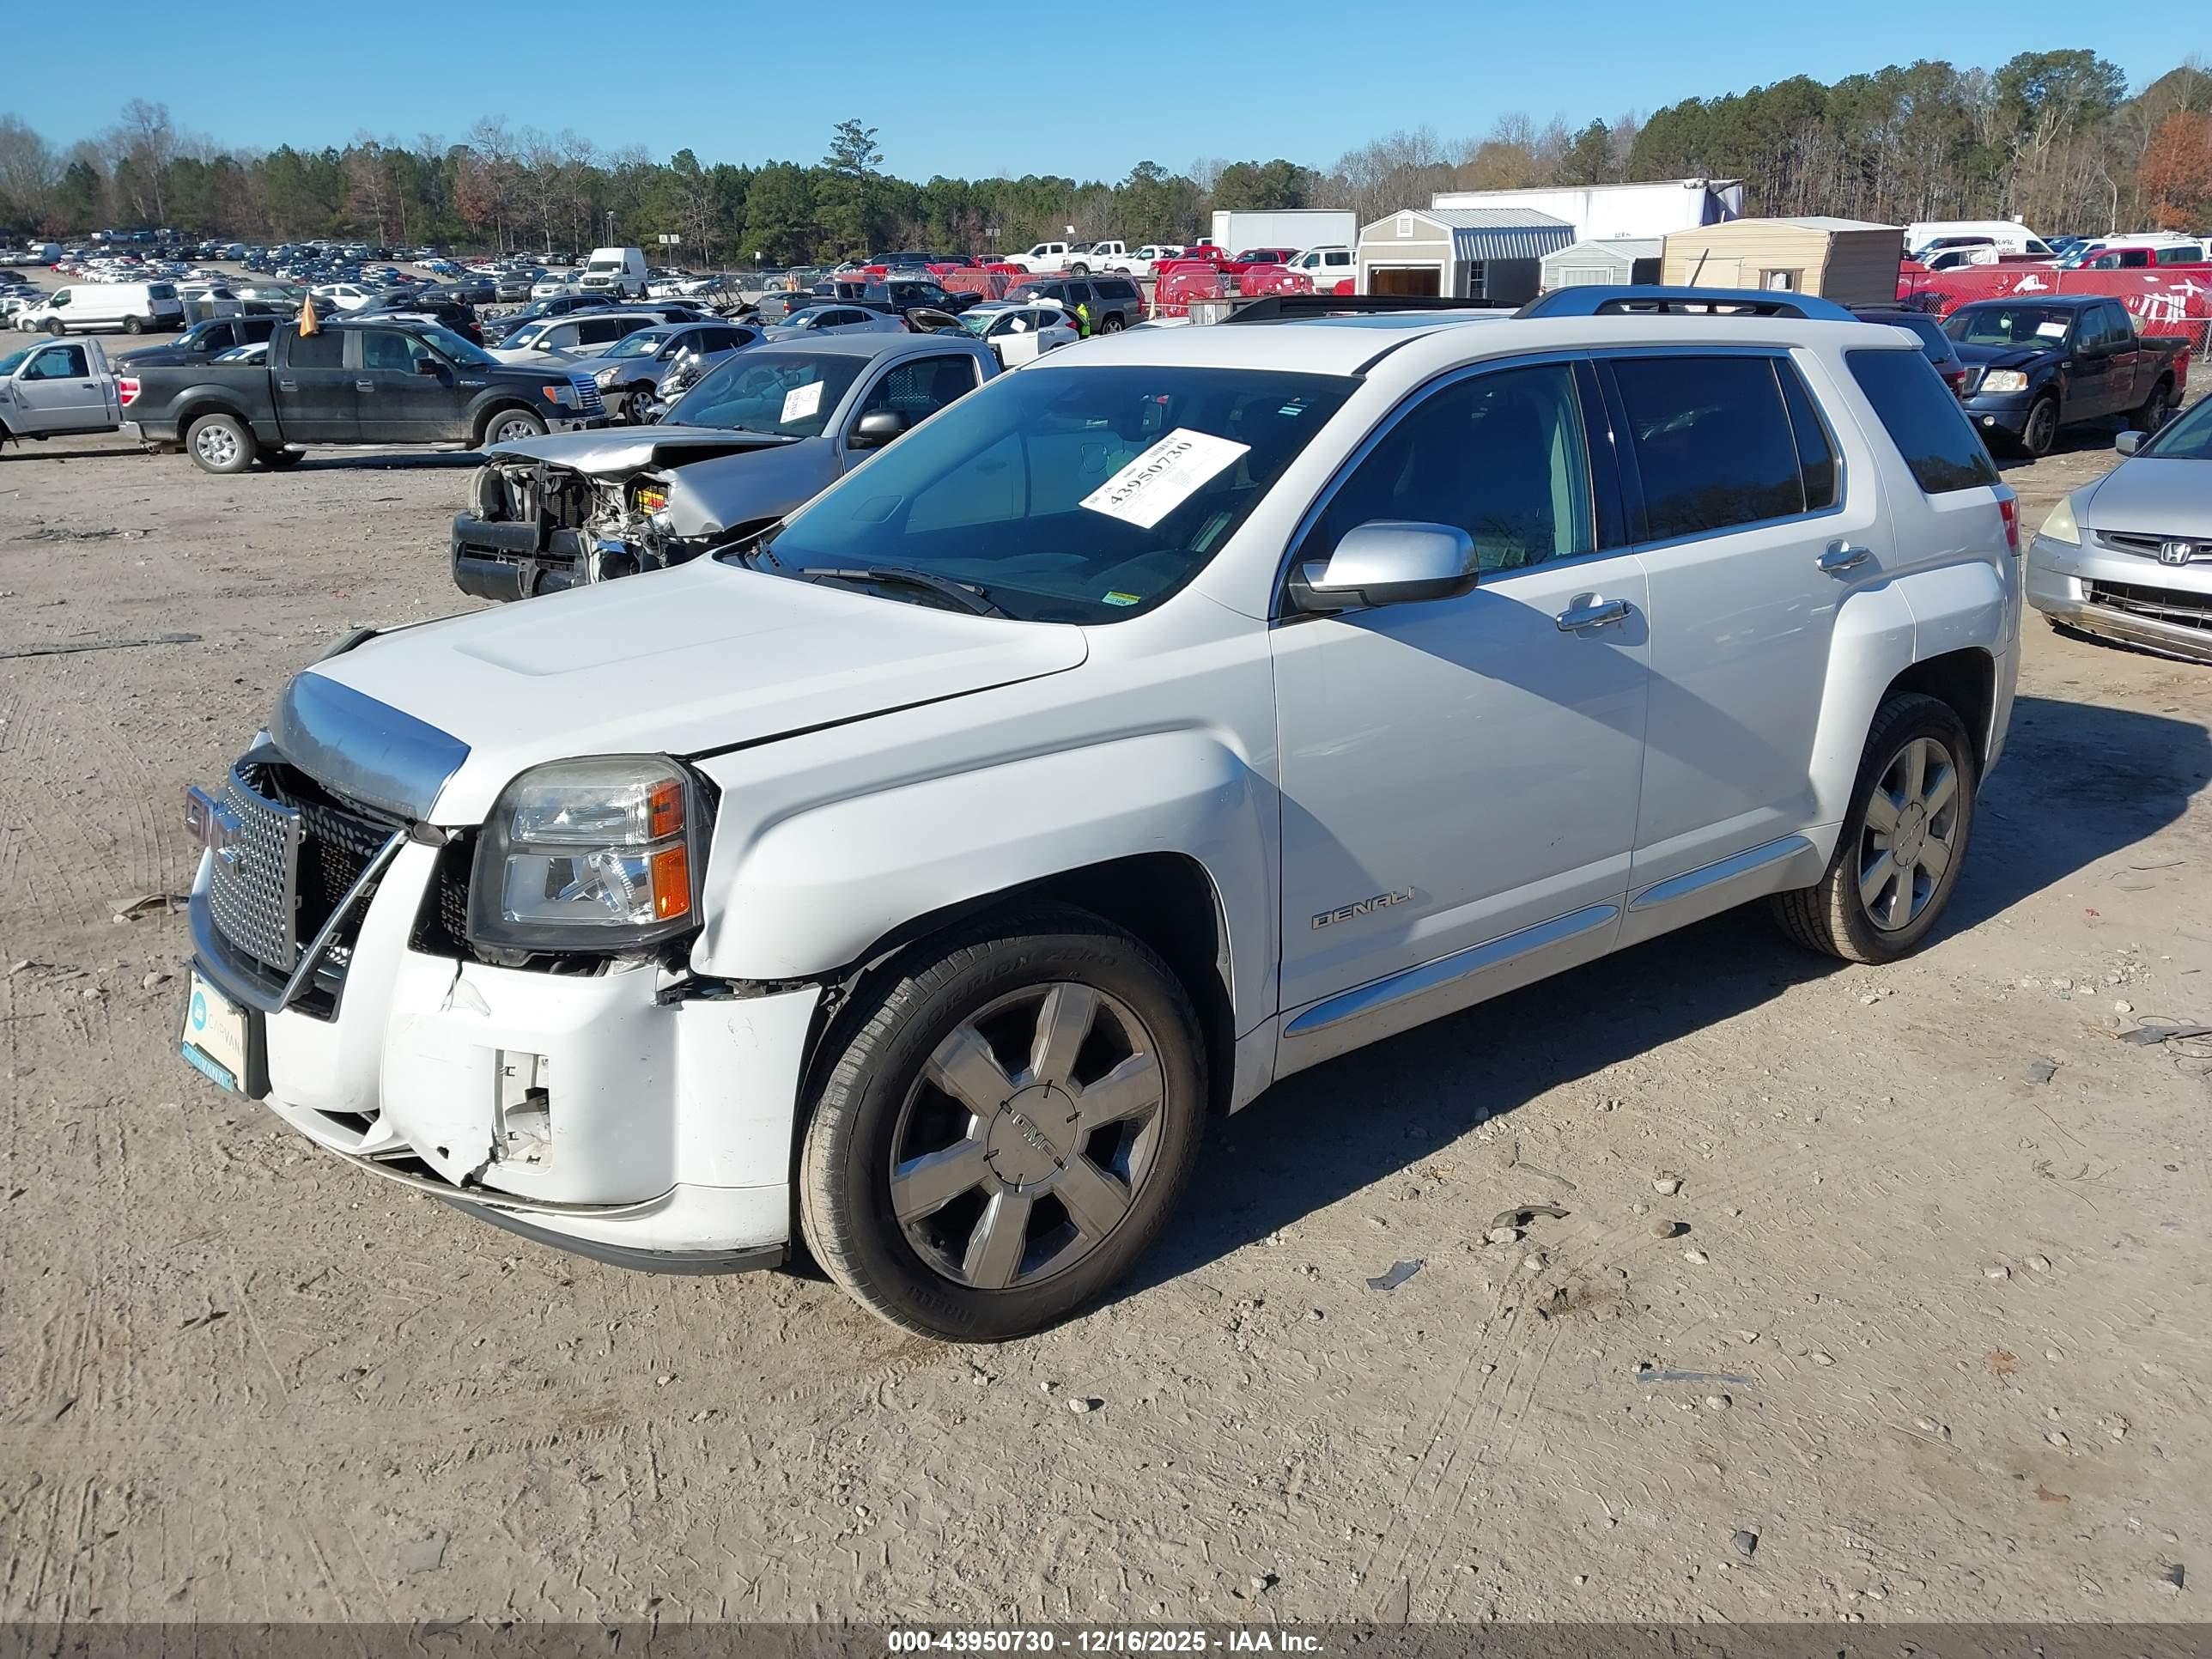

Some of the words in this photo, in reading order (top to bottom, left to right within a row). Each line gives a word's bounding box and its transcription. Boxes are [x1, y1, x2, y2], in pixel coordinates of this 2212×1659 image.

[1110, 441, 1193, 505] 43950730
[1312, 886, 1415, 930] DENALI
[1012, 1114, 1057, 1159] GMC
